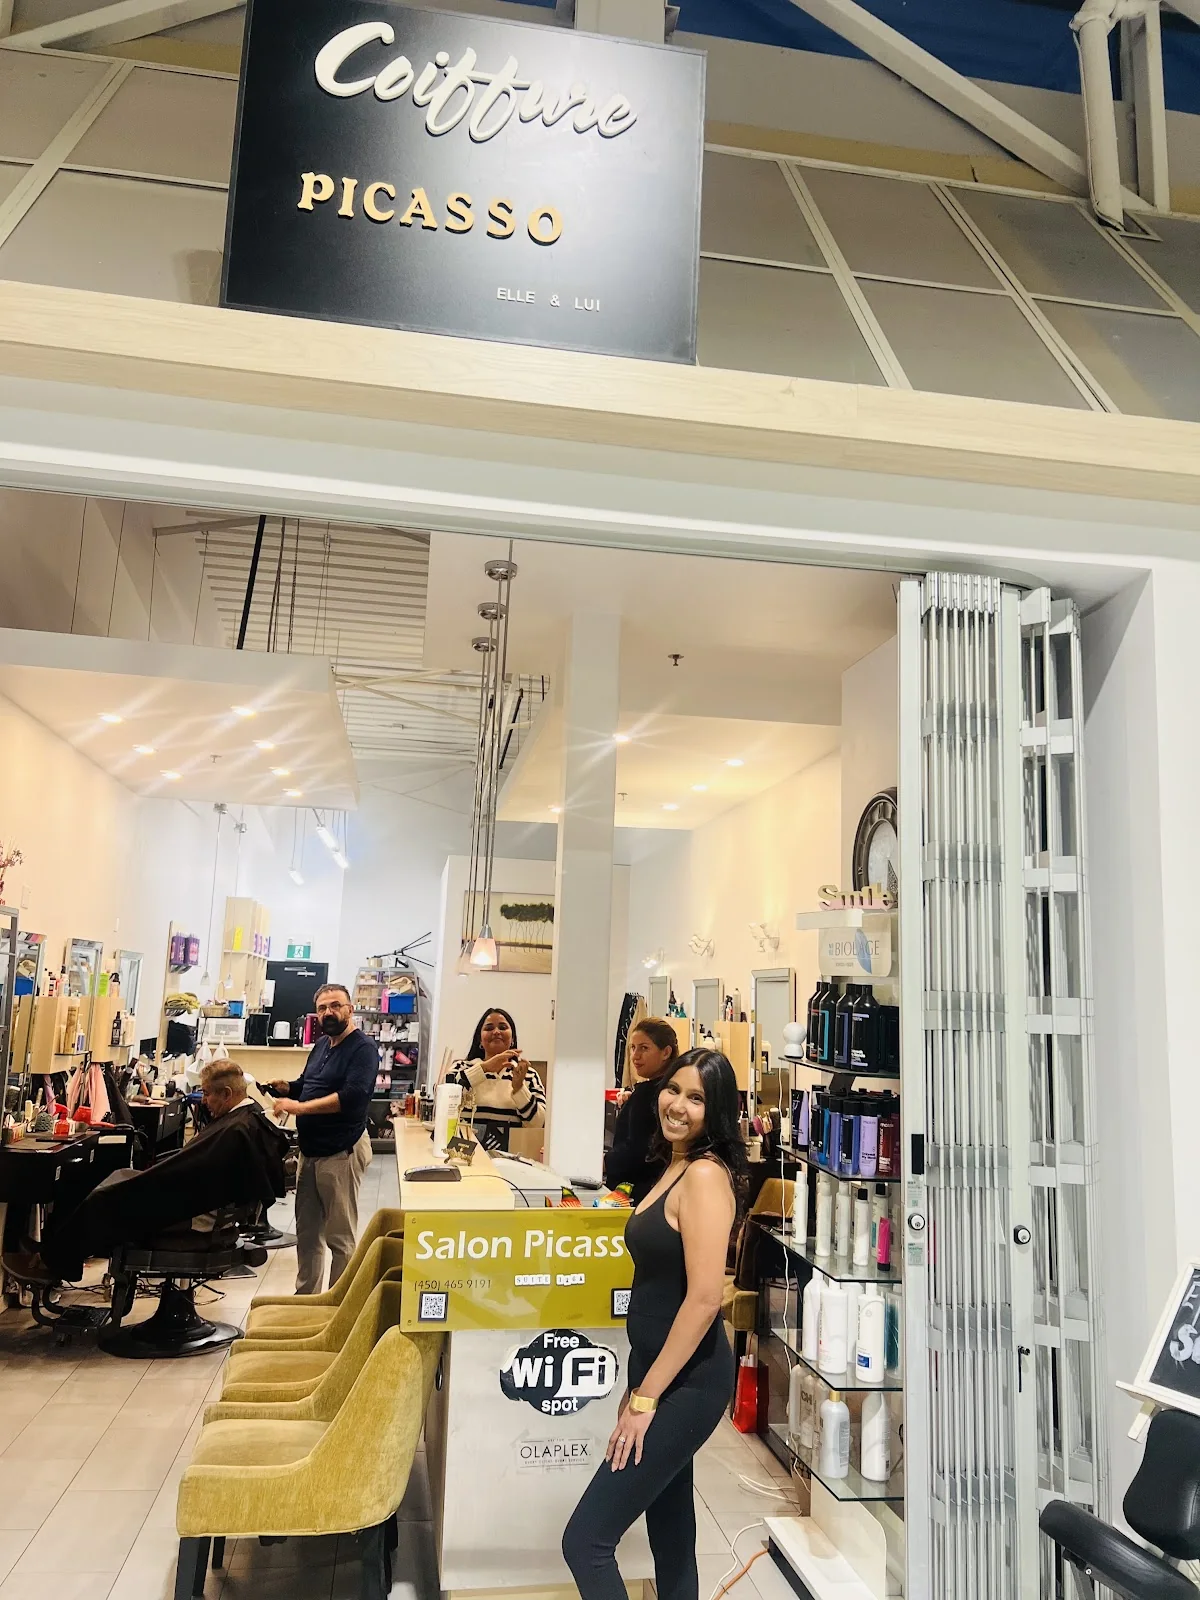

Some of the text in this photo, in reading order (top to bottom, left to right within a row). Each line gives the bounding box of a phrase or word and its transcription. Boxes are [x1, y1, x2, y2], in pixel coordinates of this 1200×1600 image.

[314, 21, 638, 143] Coiffure
[297, 171, 563, 245] PICASSO
[497, 287, 600, 312] ELLE & LUI
[835, 940, 880, 957] BIOLAGE
[415, 1229, 631, 1260] Salon Picass
[414, 1279, 492, 1292] (450) 465 9191
[543, 1333, 580, 1349] Free
[511, 1355, 607, 1388] Wi Fi
[541, 1396, 579, 1416] spot
